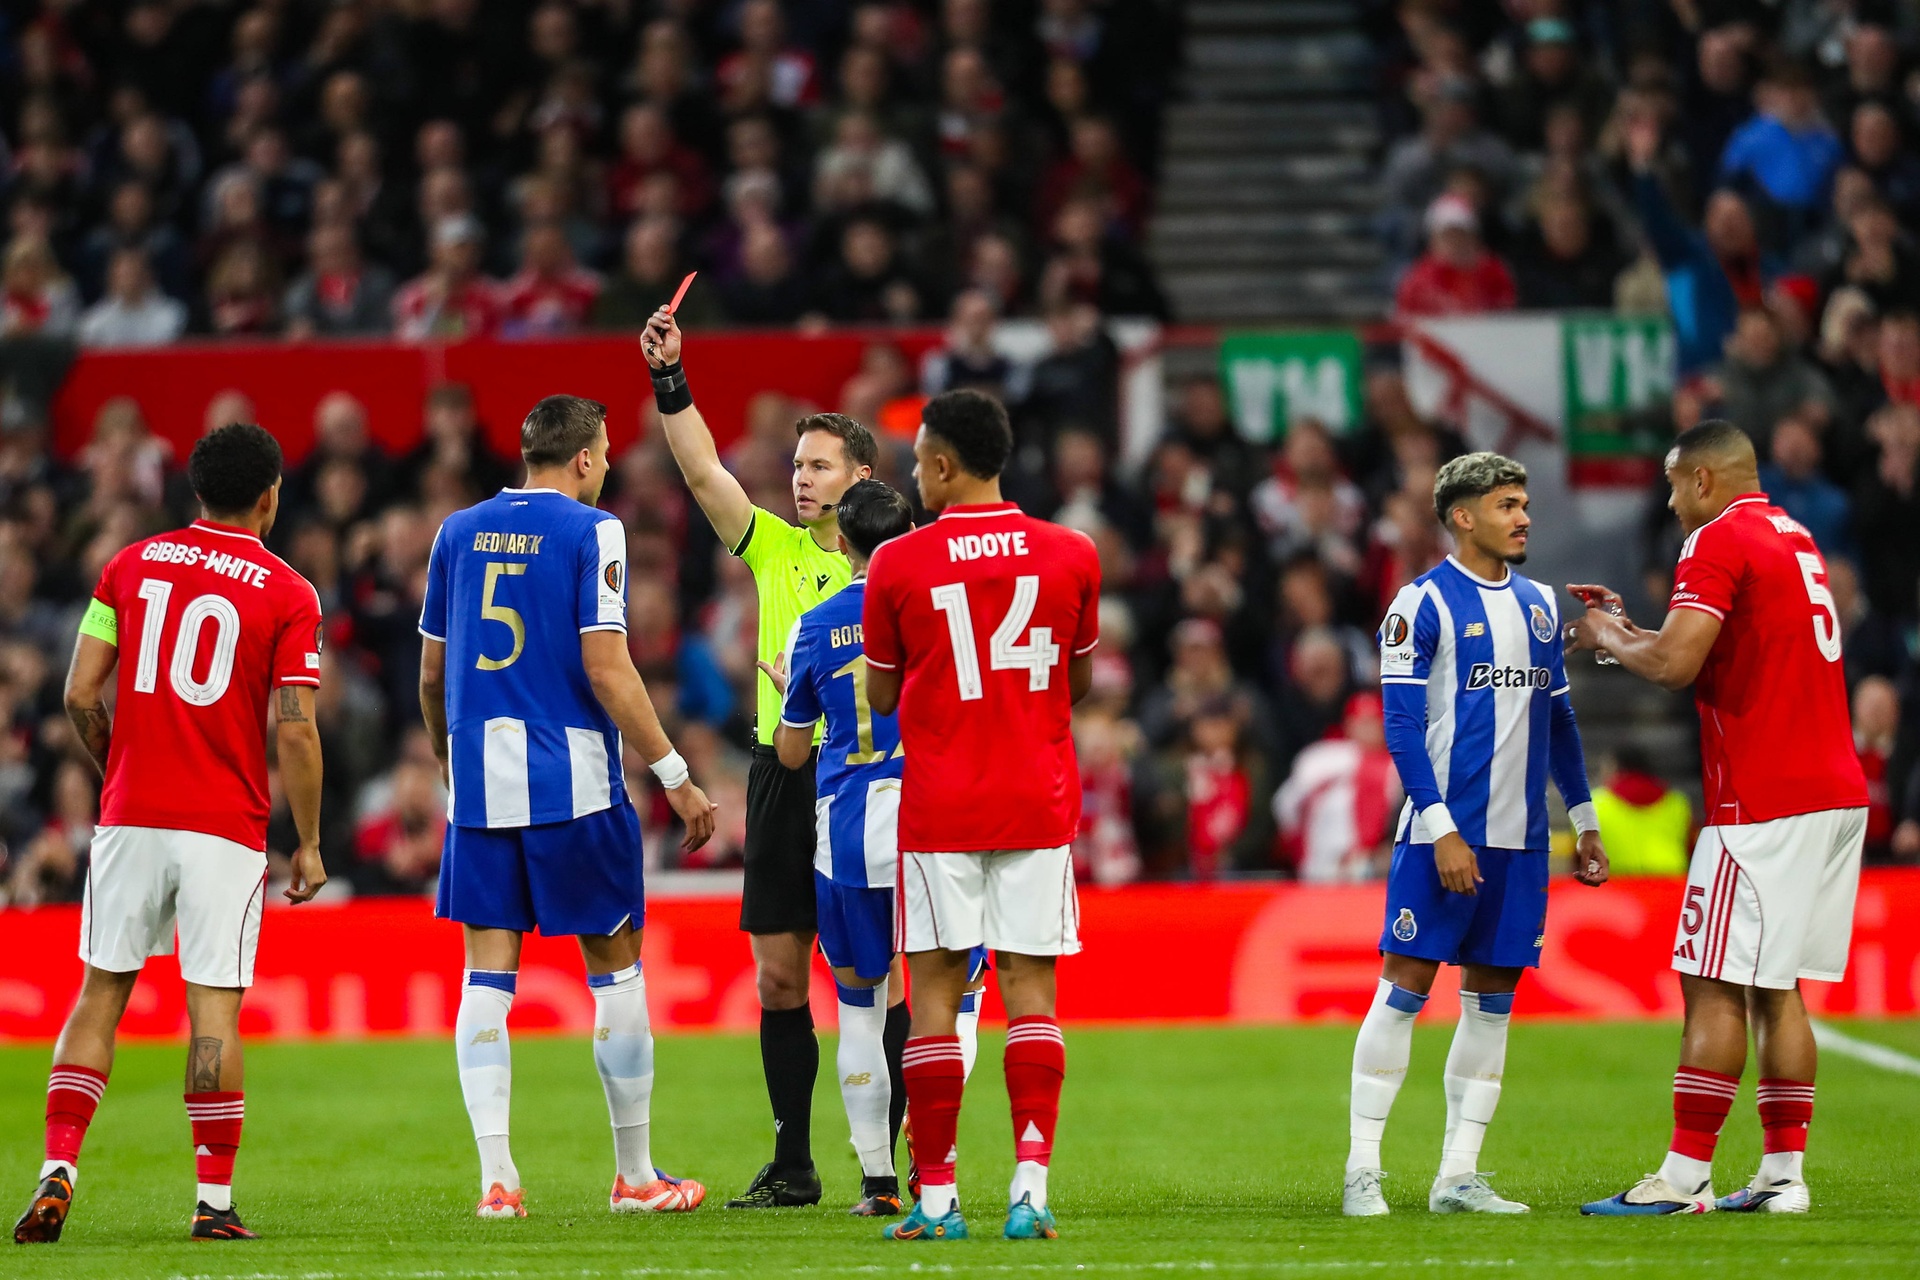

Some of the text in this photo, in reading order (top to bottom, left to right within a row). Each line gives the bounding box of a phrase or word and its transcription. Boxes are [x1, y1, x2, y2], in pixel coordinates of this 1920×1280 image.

[141, 542, 271, 589] GIBBS-WHITE
[473, 532, 544, 554] BEDNAREK
[947, 531, 1029, 563] NDOYE
[475, 562, 528, 671] 5
[1795, 551, 1842, 662] 5
[134, 578, 240, 706] 10
[930, 575, 1060, 701] 14
[1466, 663, 1550, 690] Betano
[1680, 885, 1705, 935] 5
